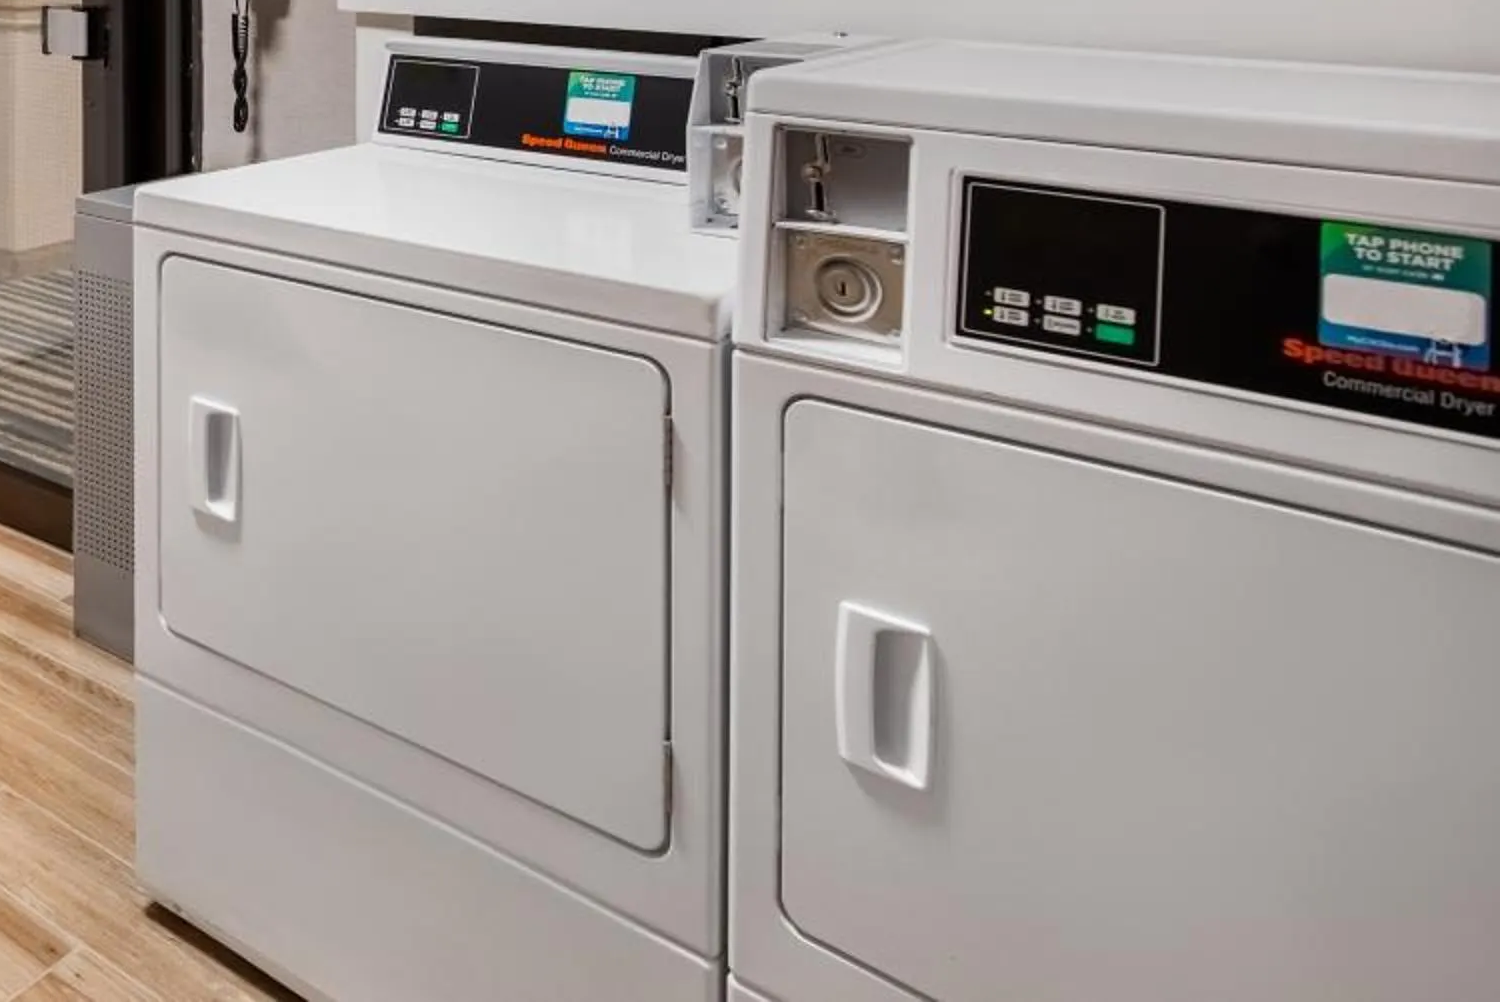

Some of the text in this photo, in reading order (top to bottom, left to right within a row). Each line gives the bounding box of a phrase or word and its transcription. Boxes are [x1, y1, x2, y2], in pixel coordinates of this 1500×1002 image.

[609, 145, 660, 160] Commercial
[1345, 232, 1465, 259] TAP PHONE
[1352, 247, 1455, 271] TO START
[1283, 337, 1385, 371] Speed
[1323, 369, 1497, 417] Commercial Dryer
